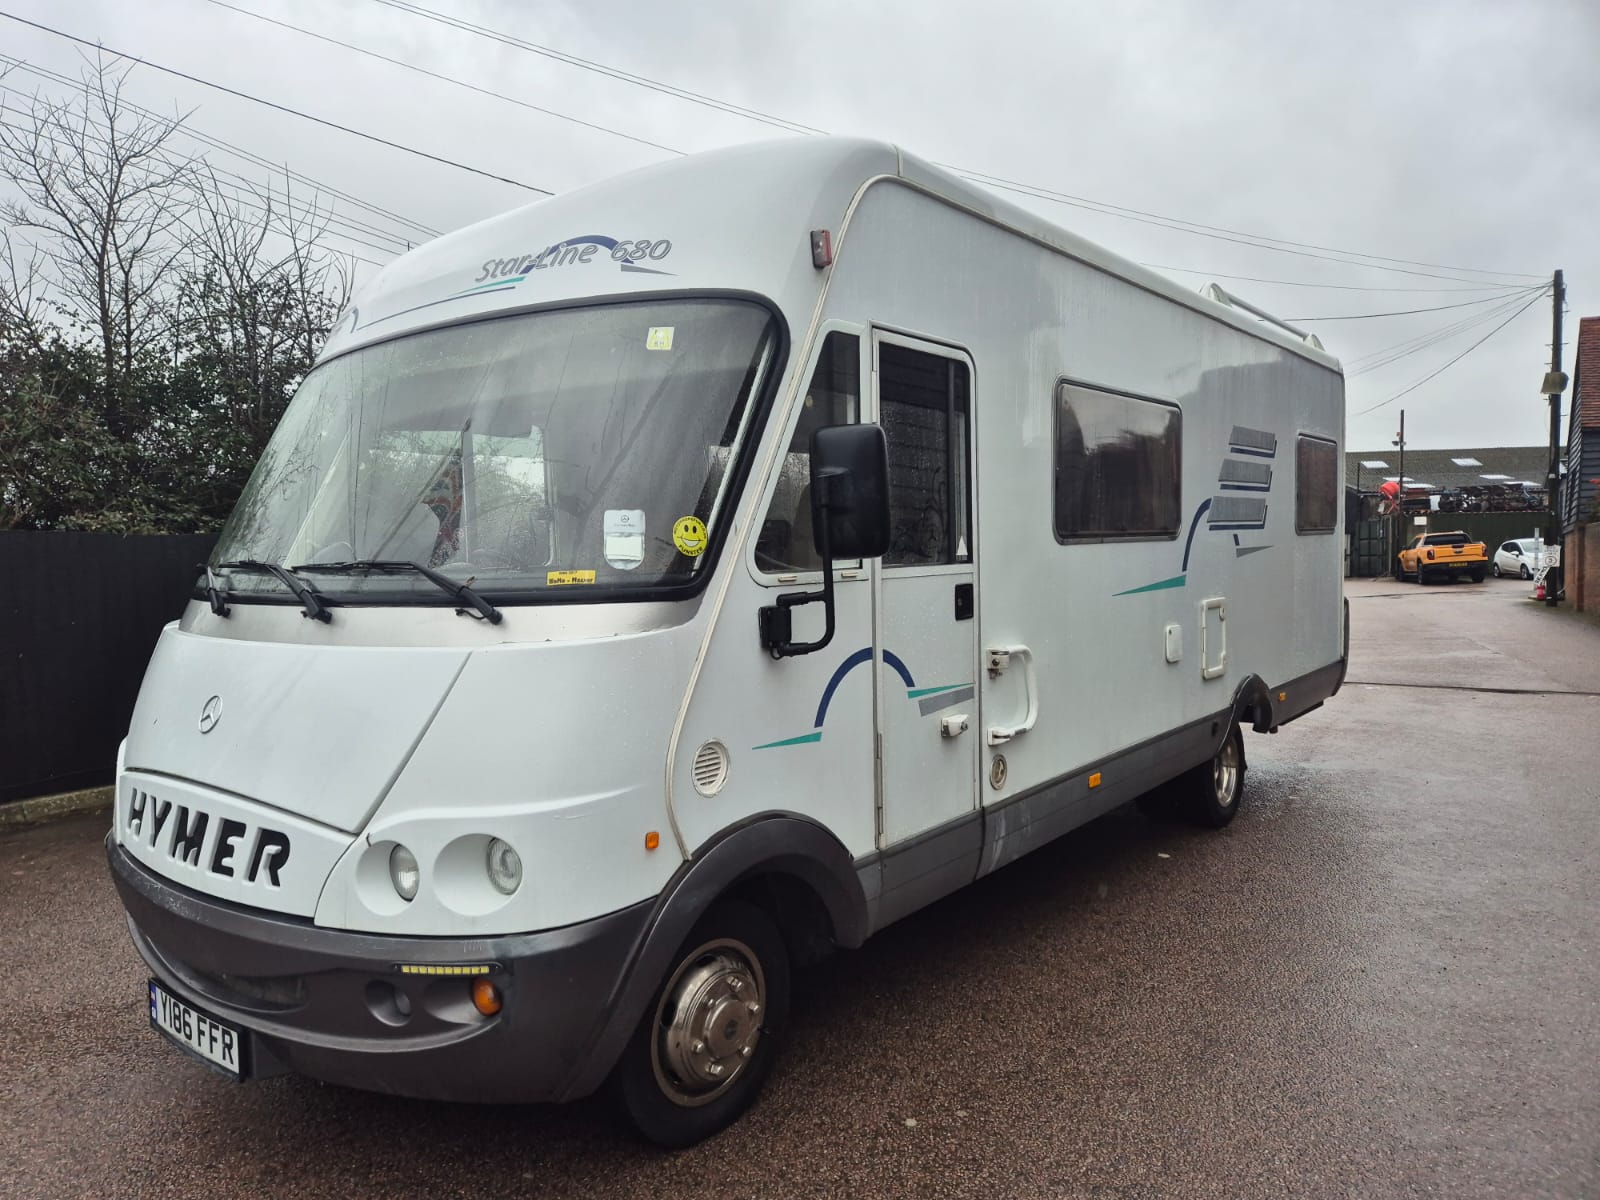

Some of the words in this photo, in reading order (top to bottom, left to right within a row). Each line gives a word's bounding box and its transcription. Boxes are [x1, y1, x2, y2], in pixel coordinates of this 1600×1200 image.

[611, 239, 672, 262] 680
[127, 787, 290, 888] HYMER
[160, 991, 192, 1041] Y186
[197, 1013, 234, 1065] FFR
